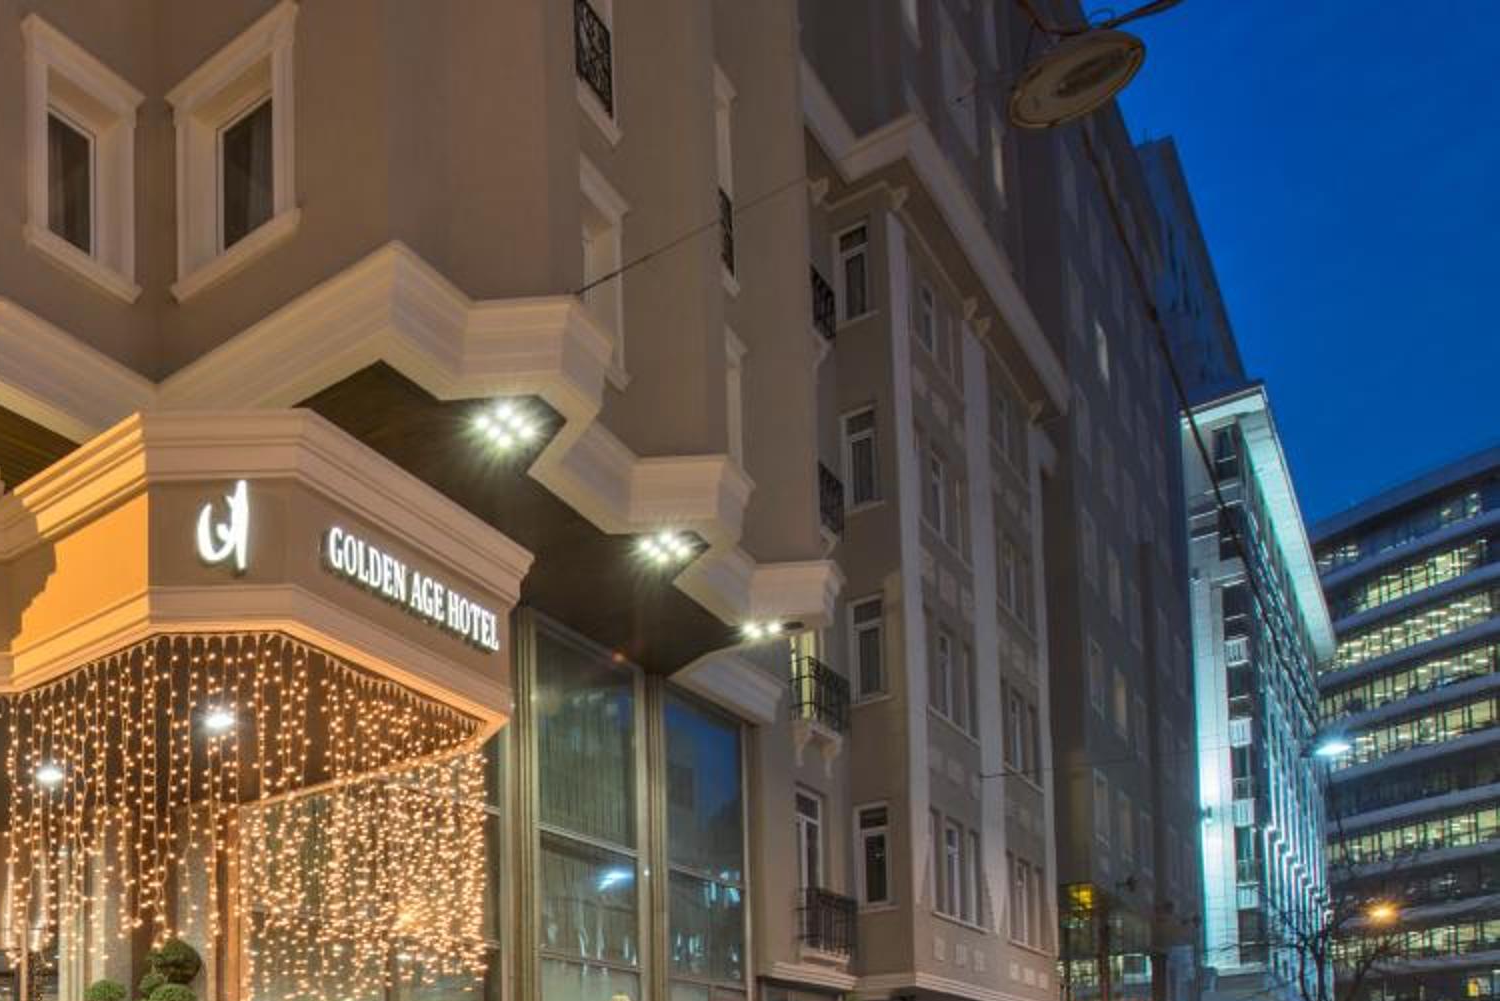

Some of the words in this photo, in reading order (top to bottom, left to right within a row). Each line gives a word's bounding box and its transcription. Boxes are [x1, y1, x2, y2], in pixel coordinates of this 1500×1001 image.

[329, 527, 406, 602] GOLDEN
[410, 571, 445, 622] AGE
[448, 589, 499, 651] HOTEL
